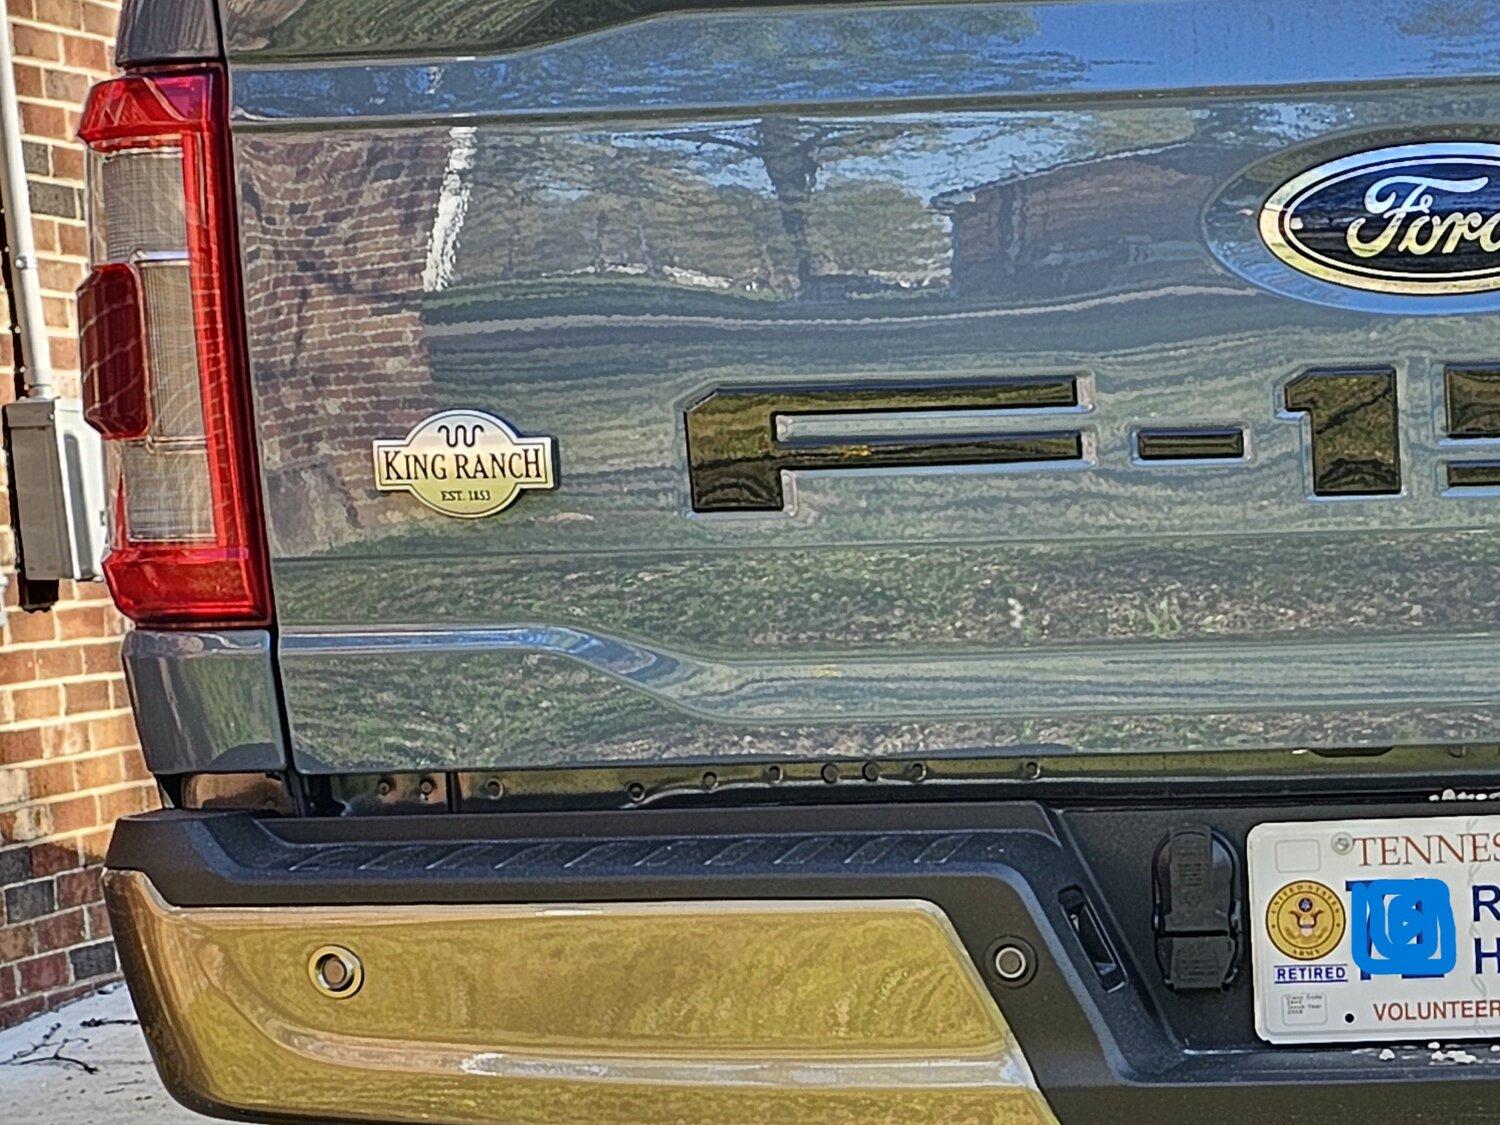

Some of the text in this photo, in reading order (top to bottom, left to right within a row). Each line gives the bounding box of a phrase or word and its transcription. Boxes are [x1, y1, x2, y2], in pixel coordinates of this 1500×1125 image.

[383, 448, 543, 480] KING RANCH
[469, 489, 492, 501] 1853
[1276, 966, 1347, 981] RETIRED
